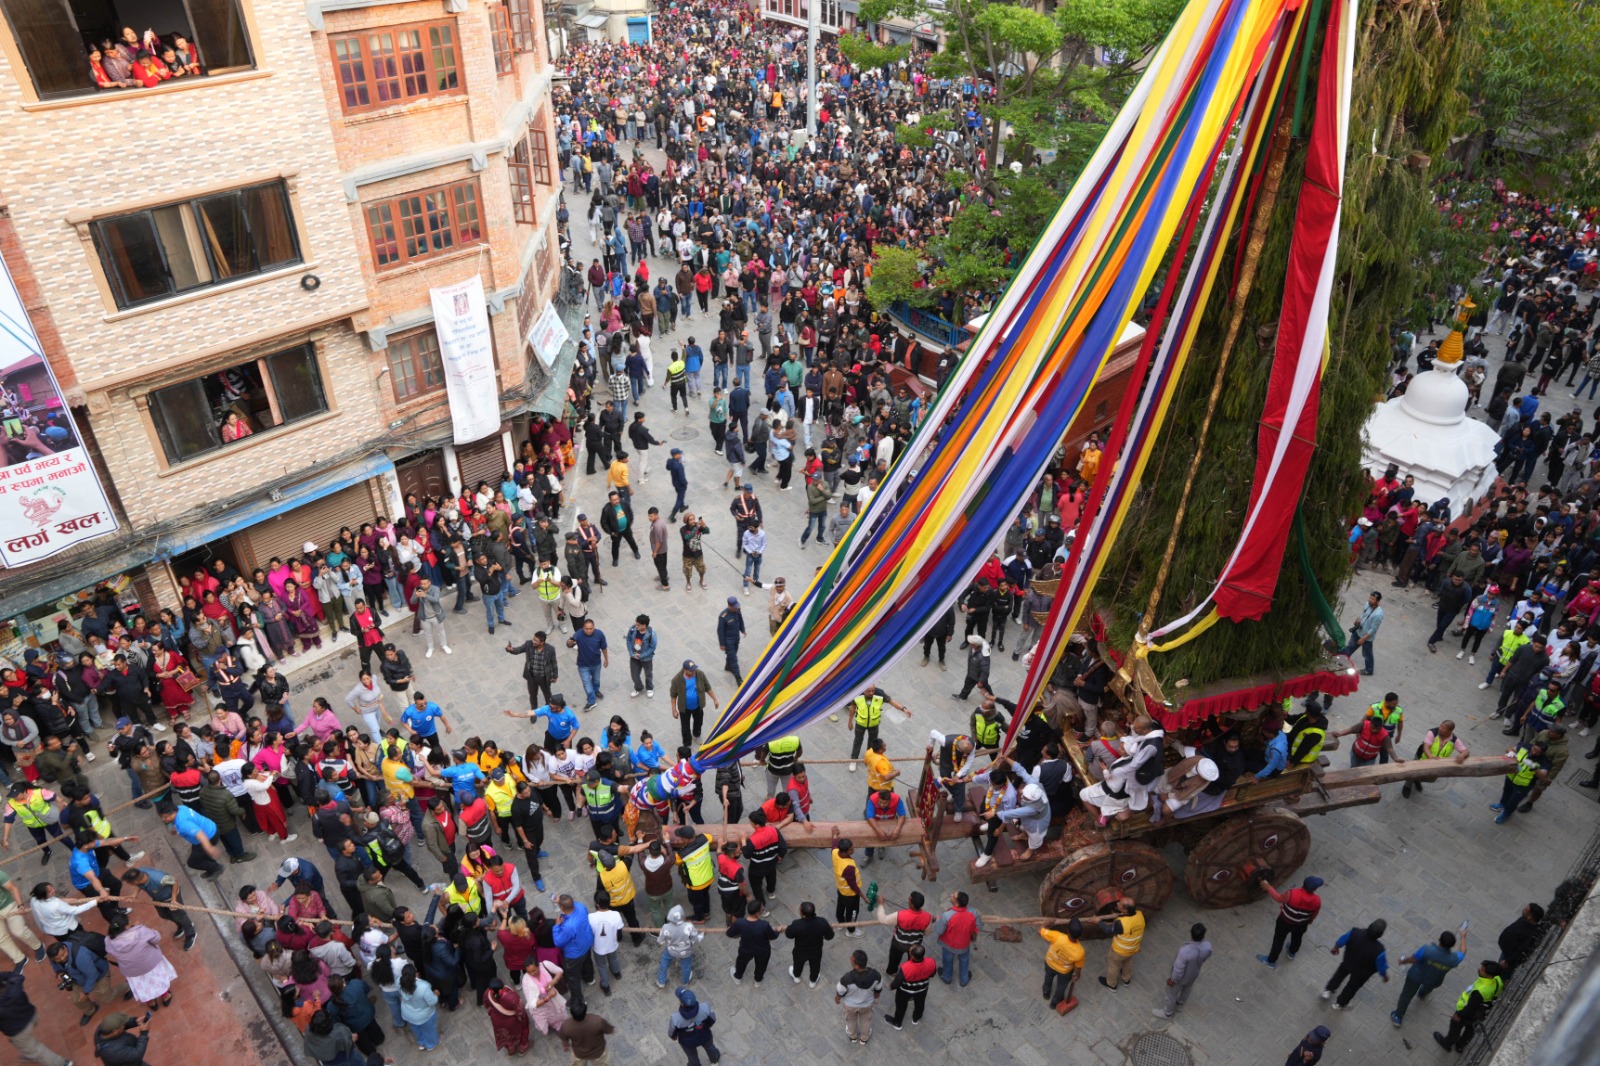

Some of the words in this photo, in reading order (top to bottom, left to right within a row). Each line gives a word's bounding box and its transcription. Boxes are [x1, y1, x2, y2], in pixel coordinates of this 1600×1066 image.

[14, 464, 31, 476] पर्व
[63, 454, 73, 462] र
[5, 528, 50, 553] लगं
